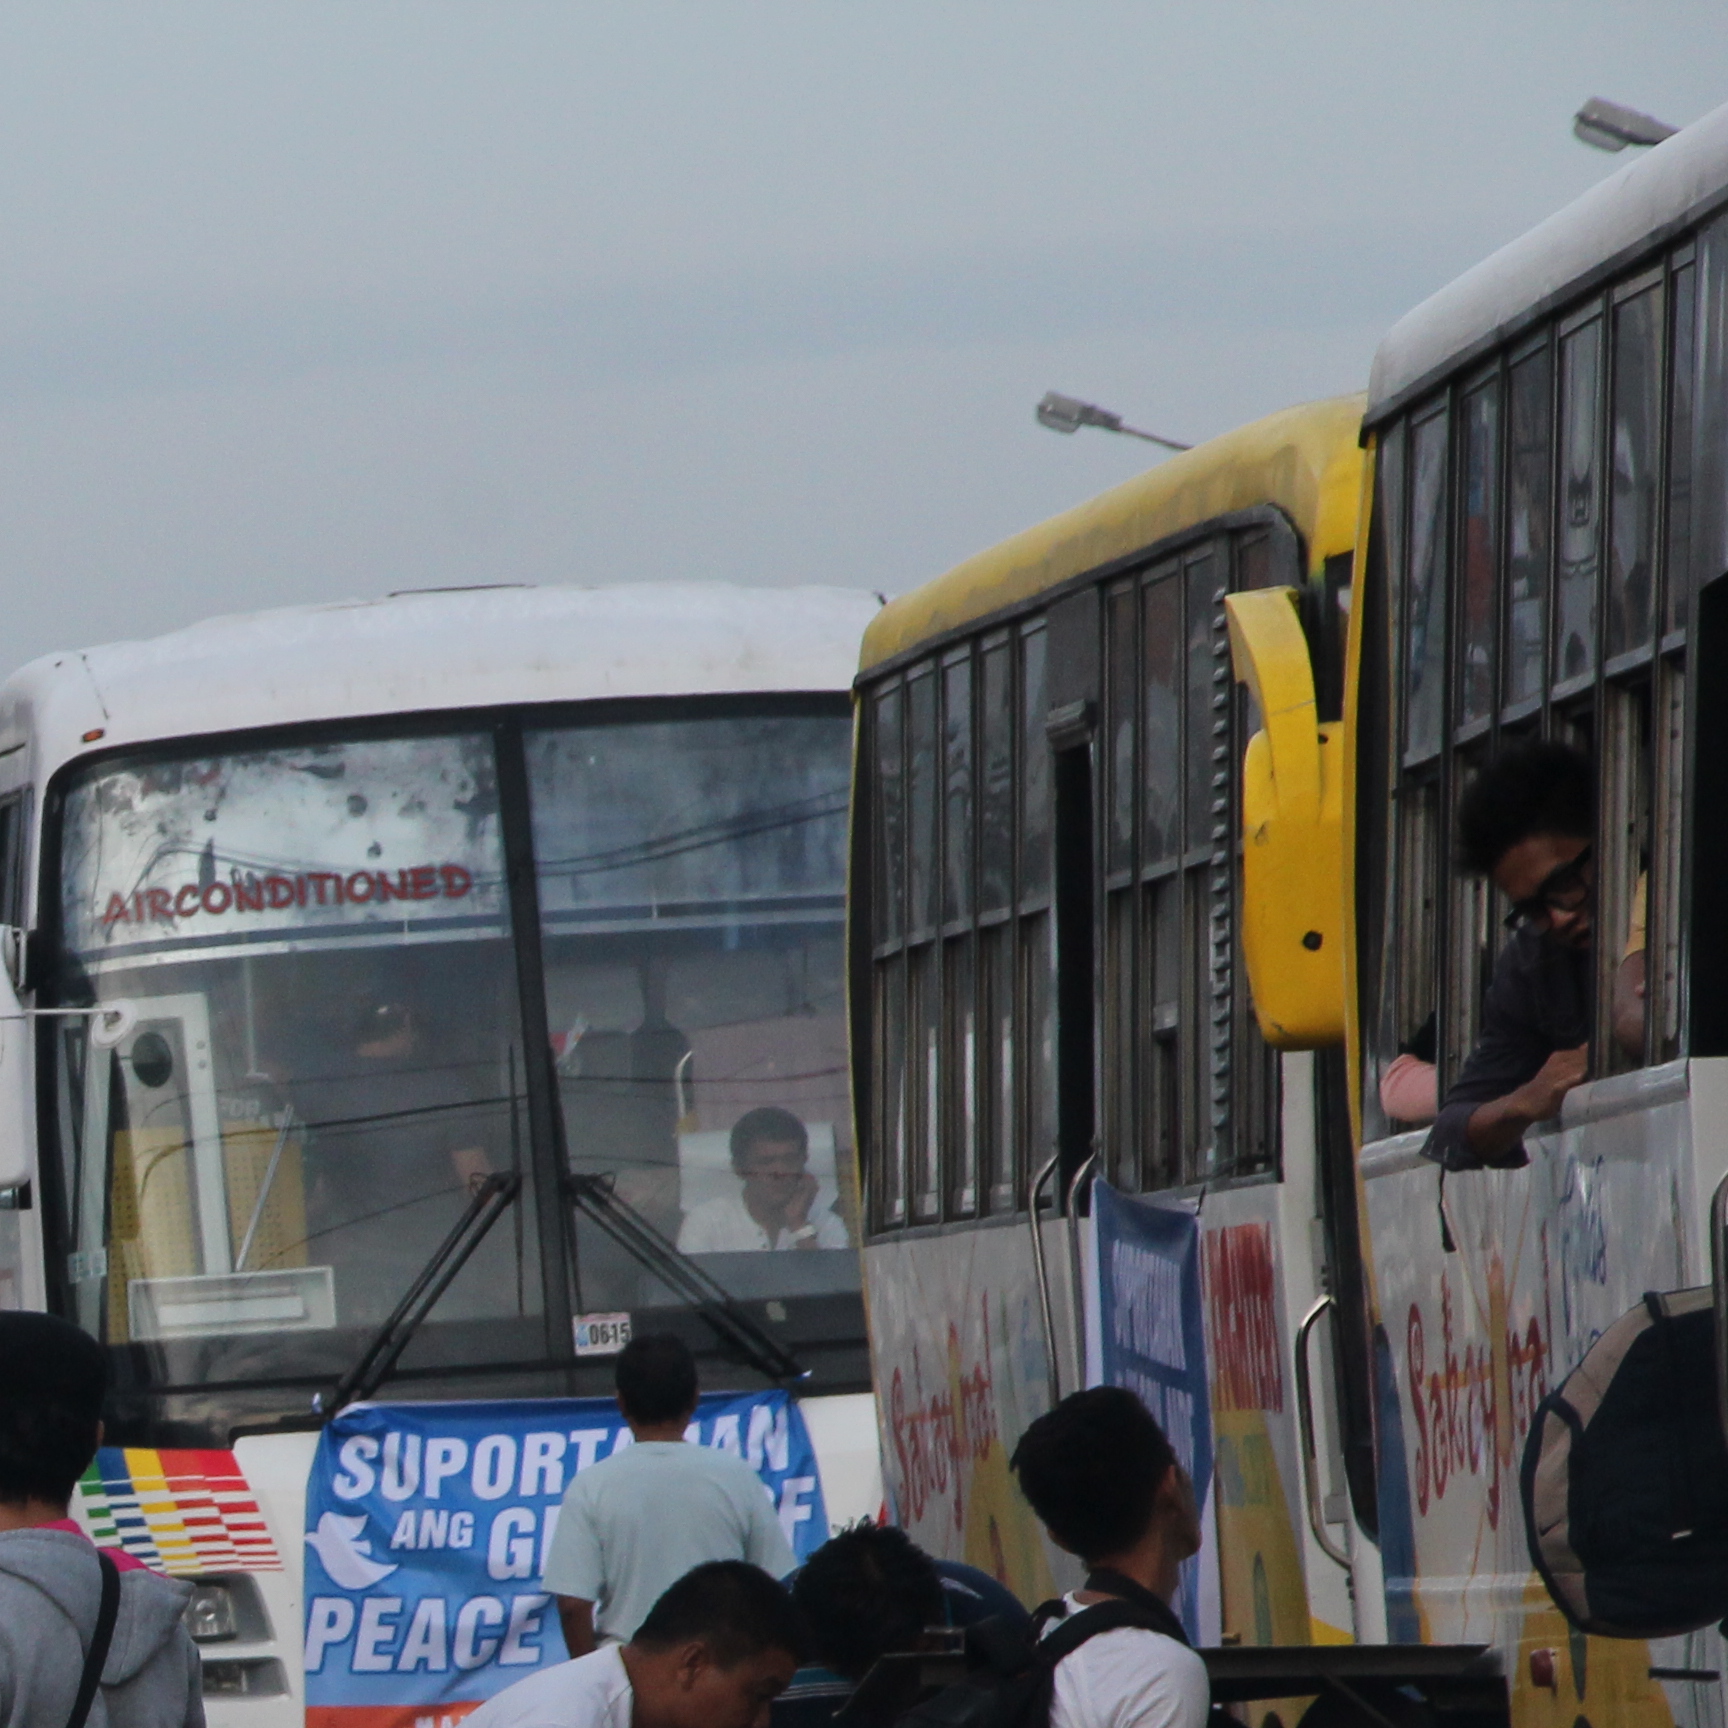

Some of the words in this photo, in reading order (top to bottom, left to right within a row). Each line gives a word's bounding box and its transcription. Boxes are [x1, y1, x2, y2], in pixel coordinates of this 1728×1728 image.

[100, 865, 472, 925] AIRCONDITIONED
[389, 1508, 475, 1552] ANG
[305, 1595, 542, 1674] PEACE
